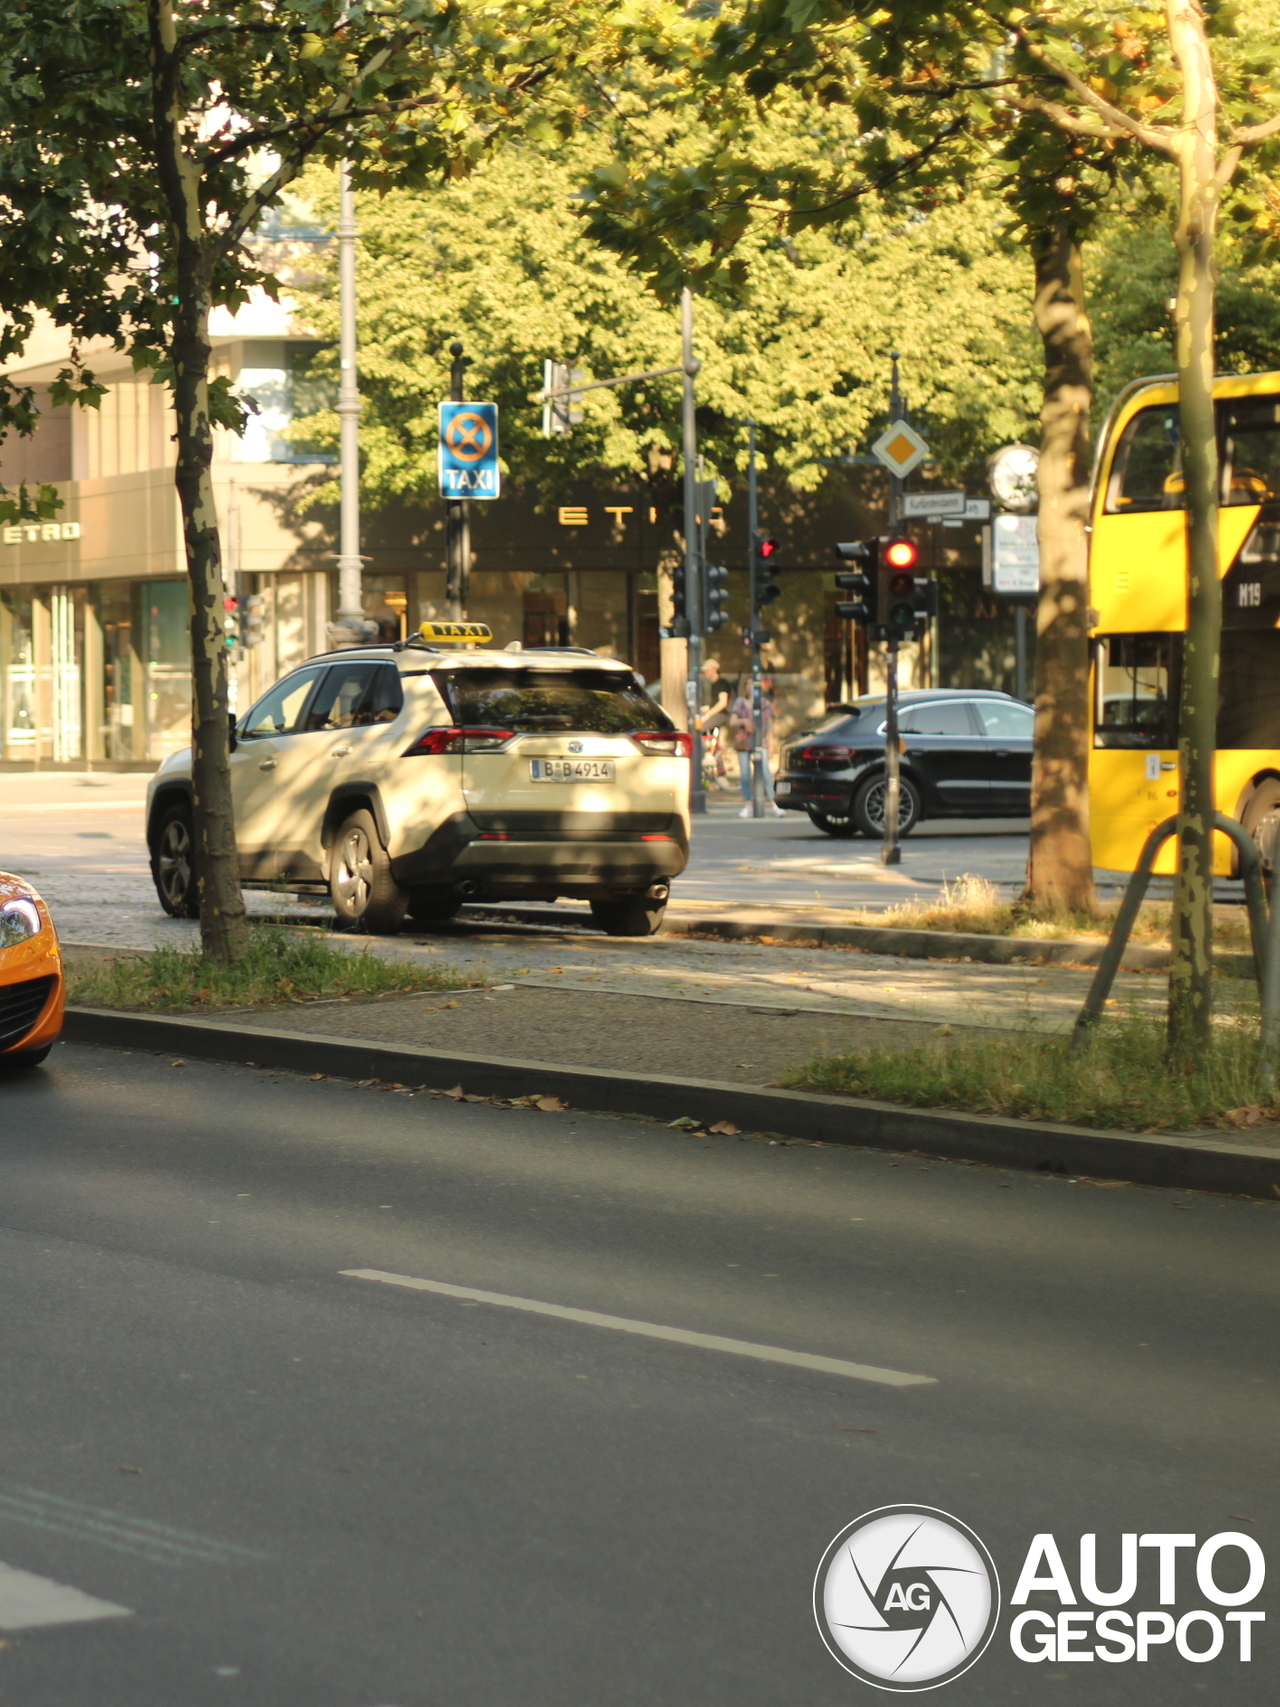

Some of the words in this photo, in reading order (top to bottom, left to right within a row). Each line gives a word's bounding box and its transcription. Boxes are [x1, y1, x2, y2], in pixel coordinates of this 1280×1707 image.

[445, 469, 493, 489] TAXI
[4, 522, 81, 545] ETRO
[1239, 583, 1261, 607] M19
[437, 625, 483, 636] TAXI
[544, 762, 554, 777] B
[563, 762, 572, 777] B
[575, 762, 608, 777] 4914
